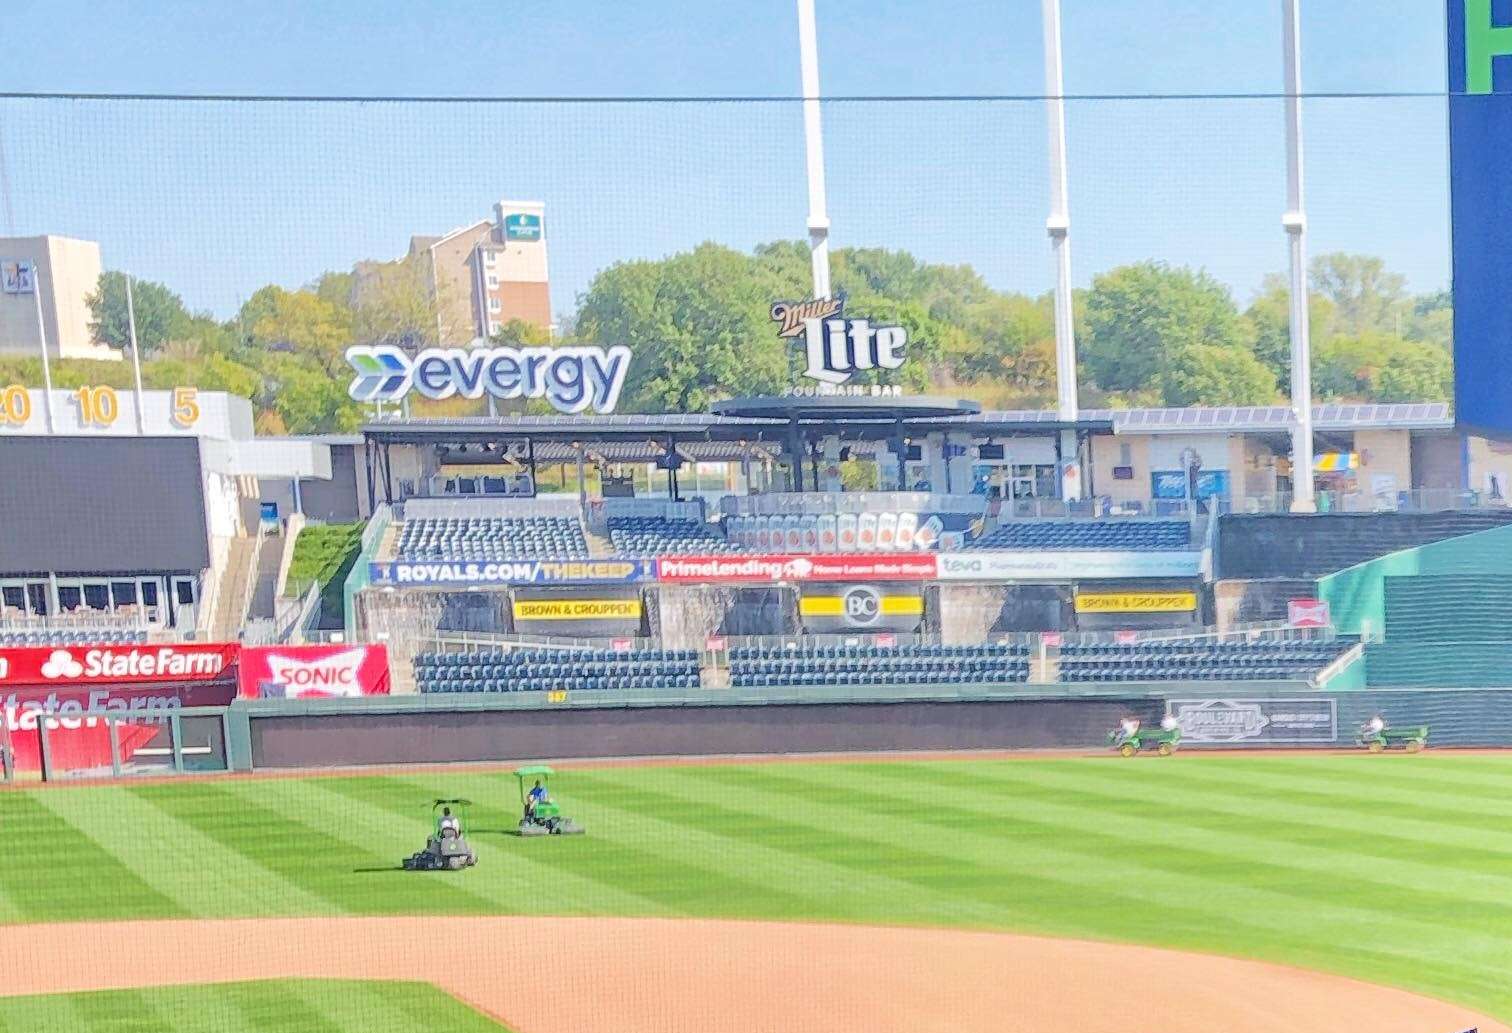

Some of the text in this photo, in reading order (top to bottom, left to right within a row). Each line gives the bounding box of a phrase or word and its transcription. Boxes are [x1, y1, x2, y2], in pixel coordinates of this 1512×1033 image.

[770, 299, 844, 334] Miller
[802, 315, 907, 384] Lite
[413, 348, 631, 409] evergy
[73, 384, 119, 425] 10
[174, 386, 200, 425] 5
[660, 559, 781, 579] PrimeLending
[521, 604, 561, 616] BROWN
[563, 604, 572, 614] &
[847, 595, 879, 616] BC
[279, 666, 353, 687] SONIC
